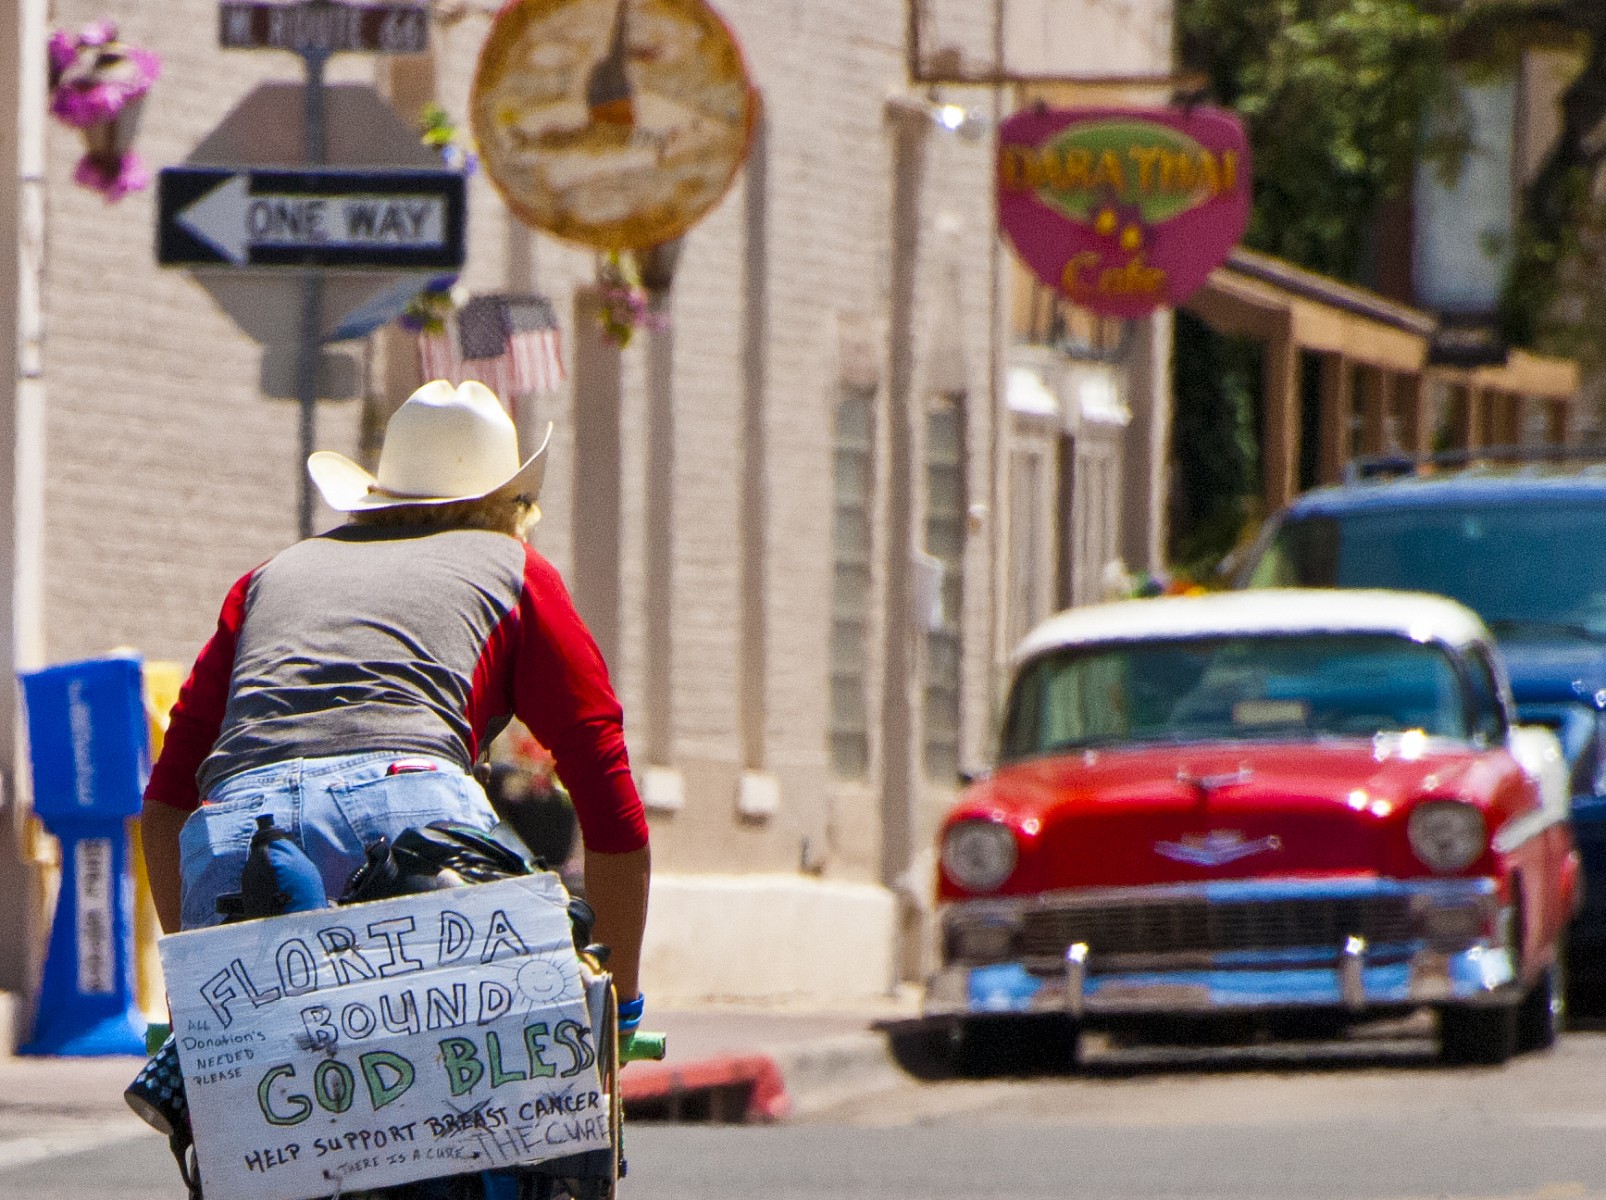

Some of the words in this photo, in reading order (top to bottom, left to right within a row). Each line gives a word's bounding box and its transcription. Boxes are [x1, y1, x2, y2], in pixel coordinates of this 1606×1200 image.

[379, 9, 426, 48] 66
[249, 199, 327, 239] ONE
[344, 199, 432, 239] WAY
[200, 909, 530, 1029] FLORIDA
[188, 1019, 211, 1032] ALL
[300, 981, 512, 1047] BOUND
[196, 1049, 254, 1070] NEEDED
[257, 1050, 416, 1126] GOD
[243, 1142, 300, 1174] HELP
[313, 1121, 417, 1158] SUPPORT
[518, 1090, 599, 1122] CANCER
